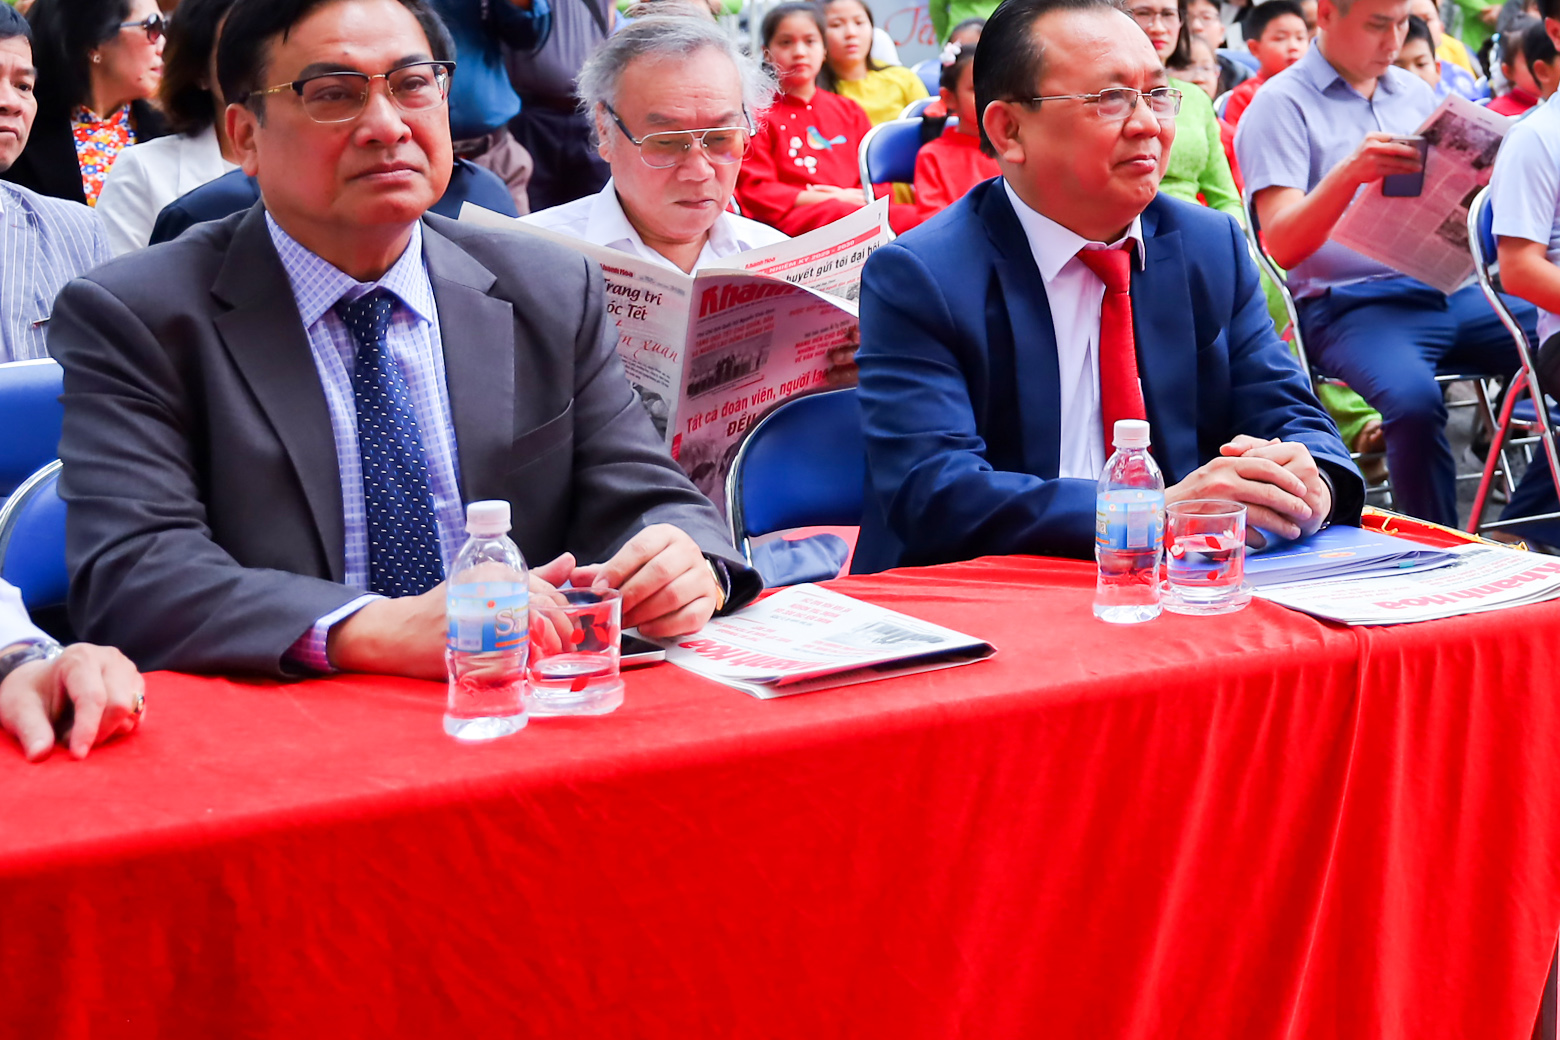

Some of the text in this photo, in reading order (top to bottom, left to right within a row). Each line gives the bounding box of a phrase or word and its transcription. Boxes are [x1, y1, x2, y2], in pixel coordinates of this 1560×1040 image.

[644, 290, 663, 306] trí
[607, 300, 648, 321] óc Tết
[686, 414, 702, 433] Tất
[704, 408, 718, 425] cả
[721, 395, 748, 418] đoàn
[751, 386, 776, 406] viên,
[779, 371, 809, 397] người
